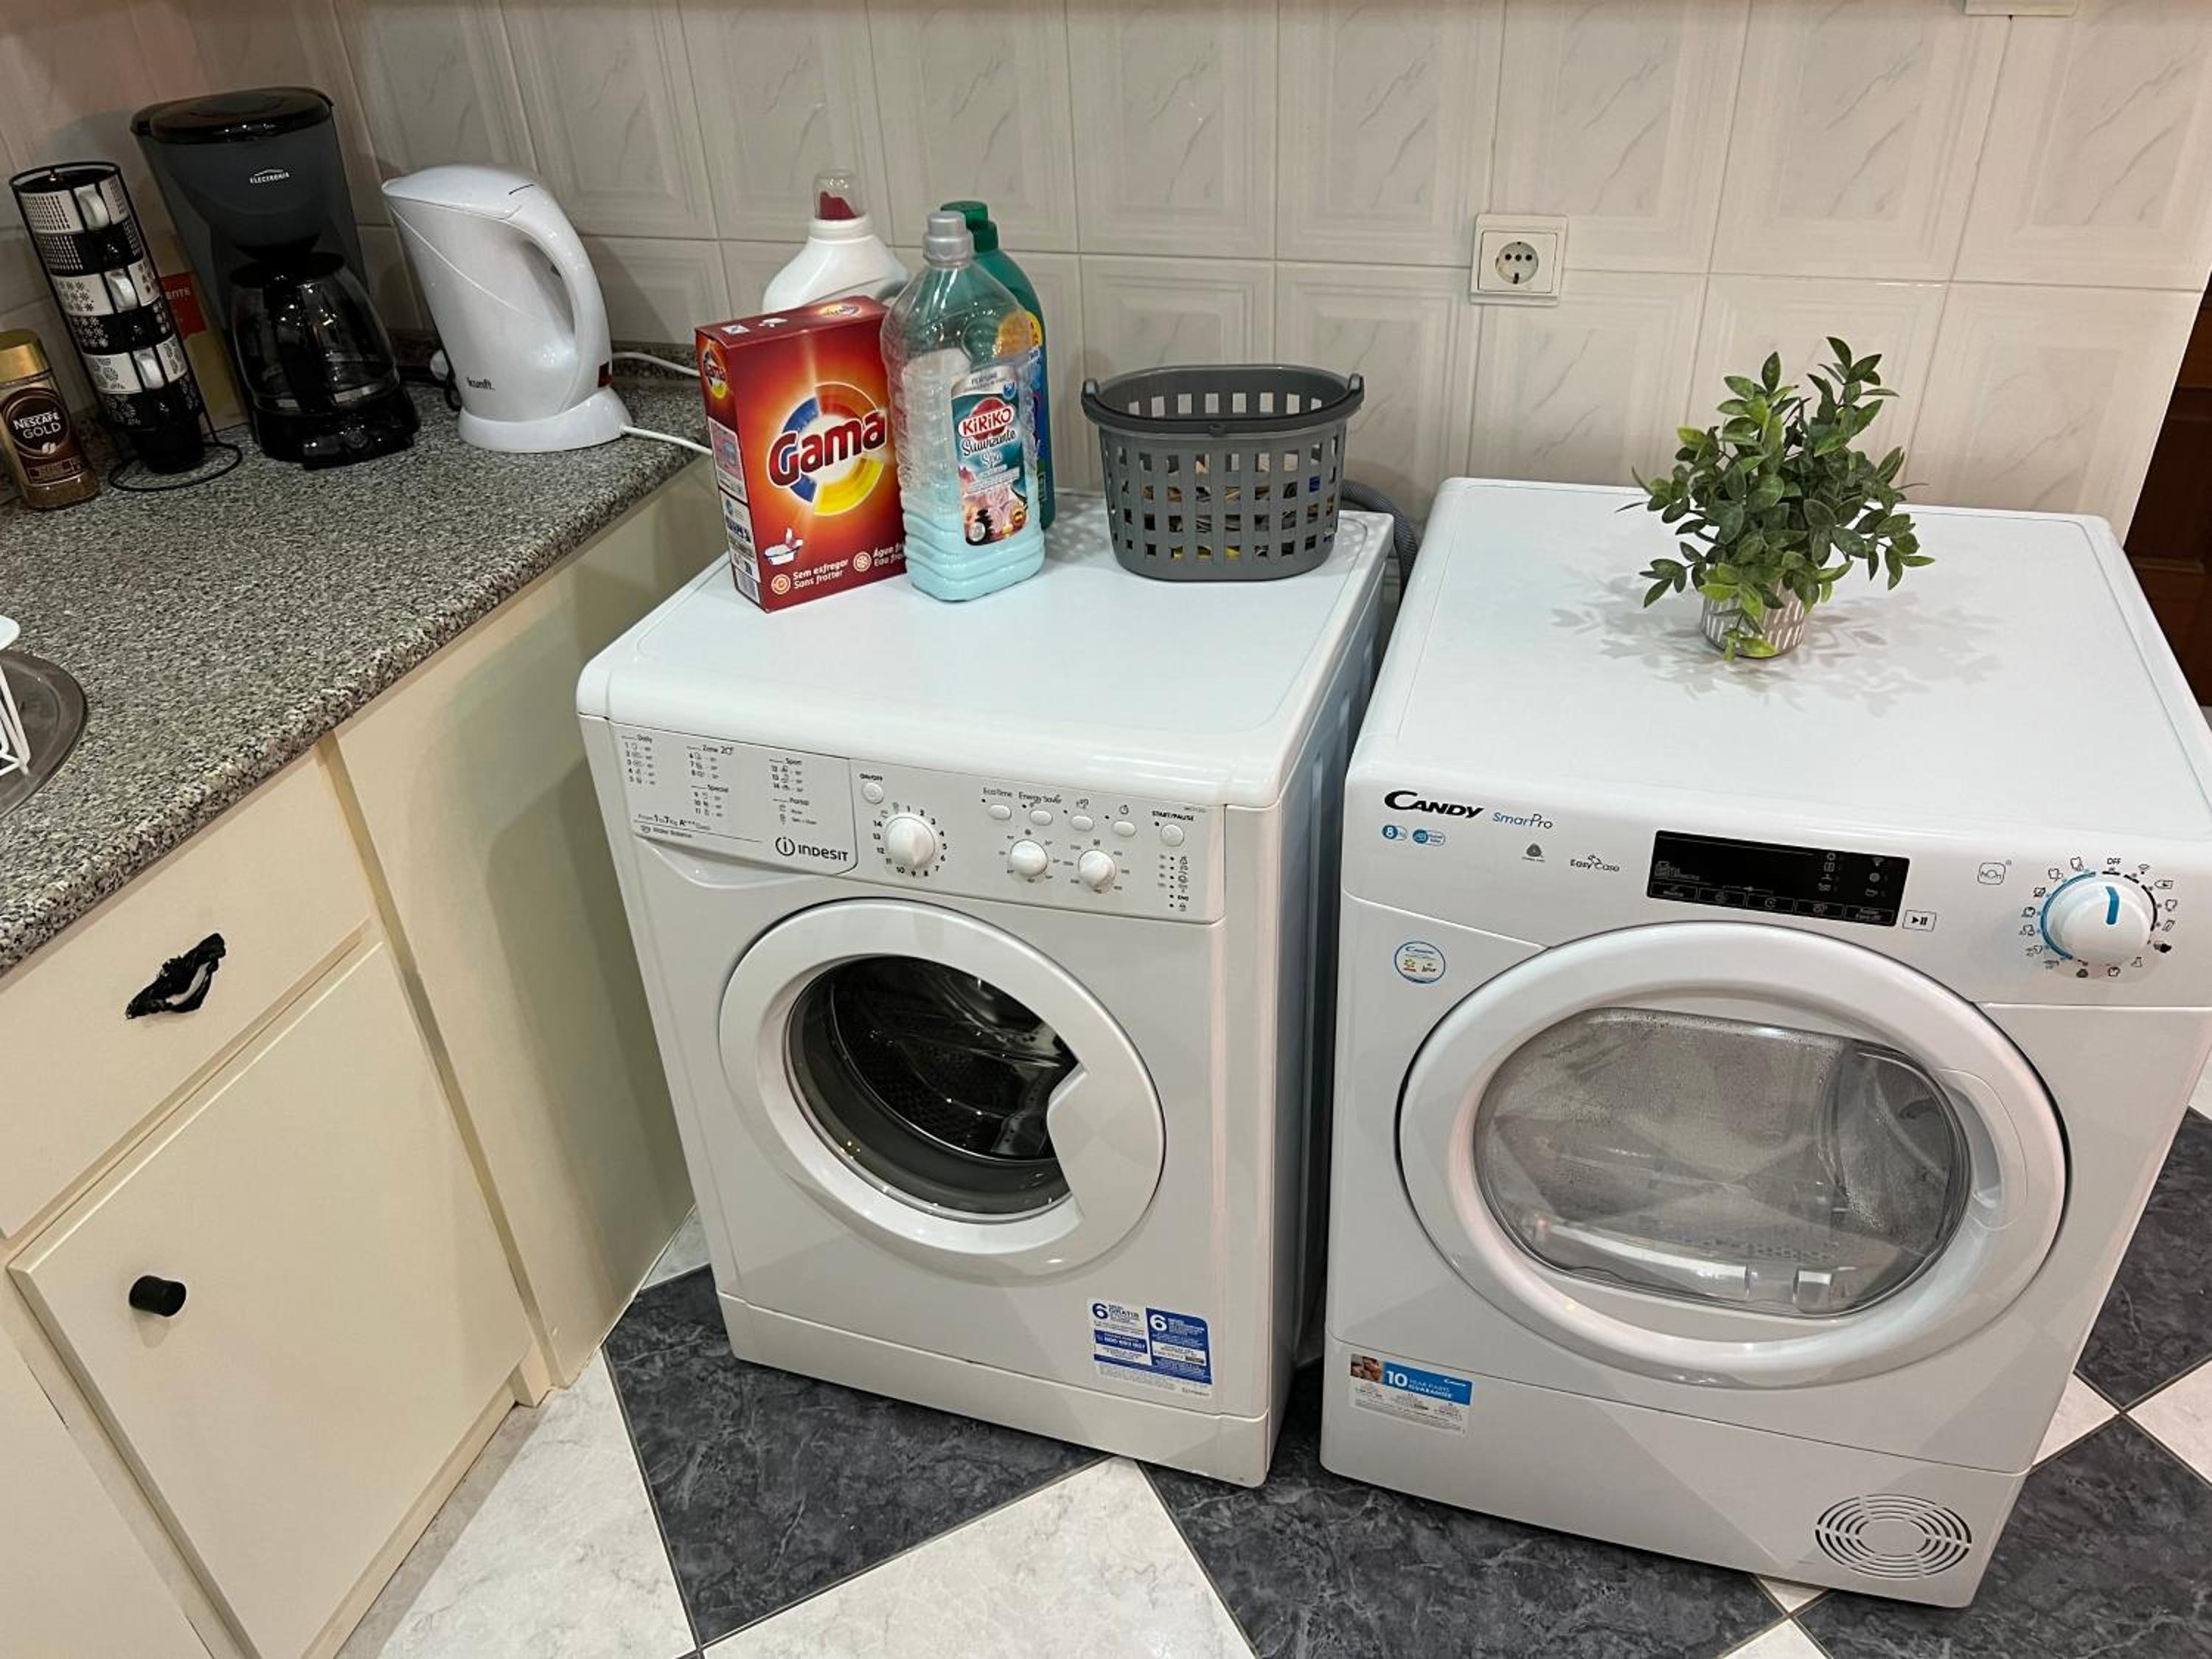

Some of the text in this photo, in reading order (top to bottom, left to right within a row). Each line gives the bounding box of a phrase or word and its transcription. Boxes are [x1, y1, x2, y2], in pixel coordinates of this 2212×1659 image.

[23, 422, 61, 439] GOLD
[767, 409, 887, 489] Gama
[793, 559, 849, 580] Sem esfregar
[793, 569, 844, 589] Sans frotter
[1092, 1303, 1109, 1320] 6
[1150, 1314, 1167, 1332] 6
[1387, 1371, 1408, 1387] 10
